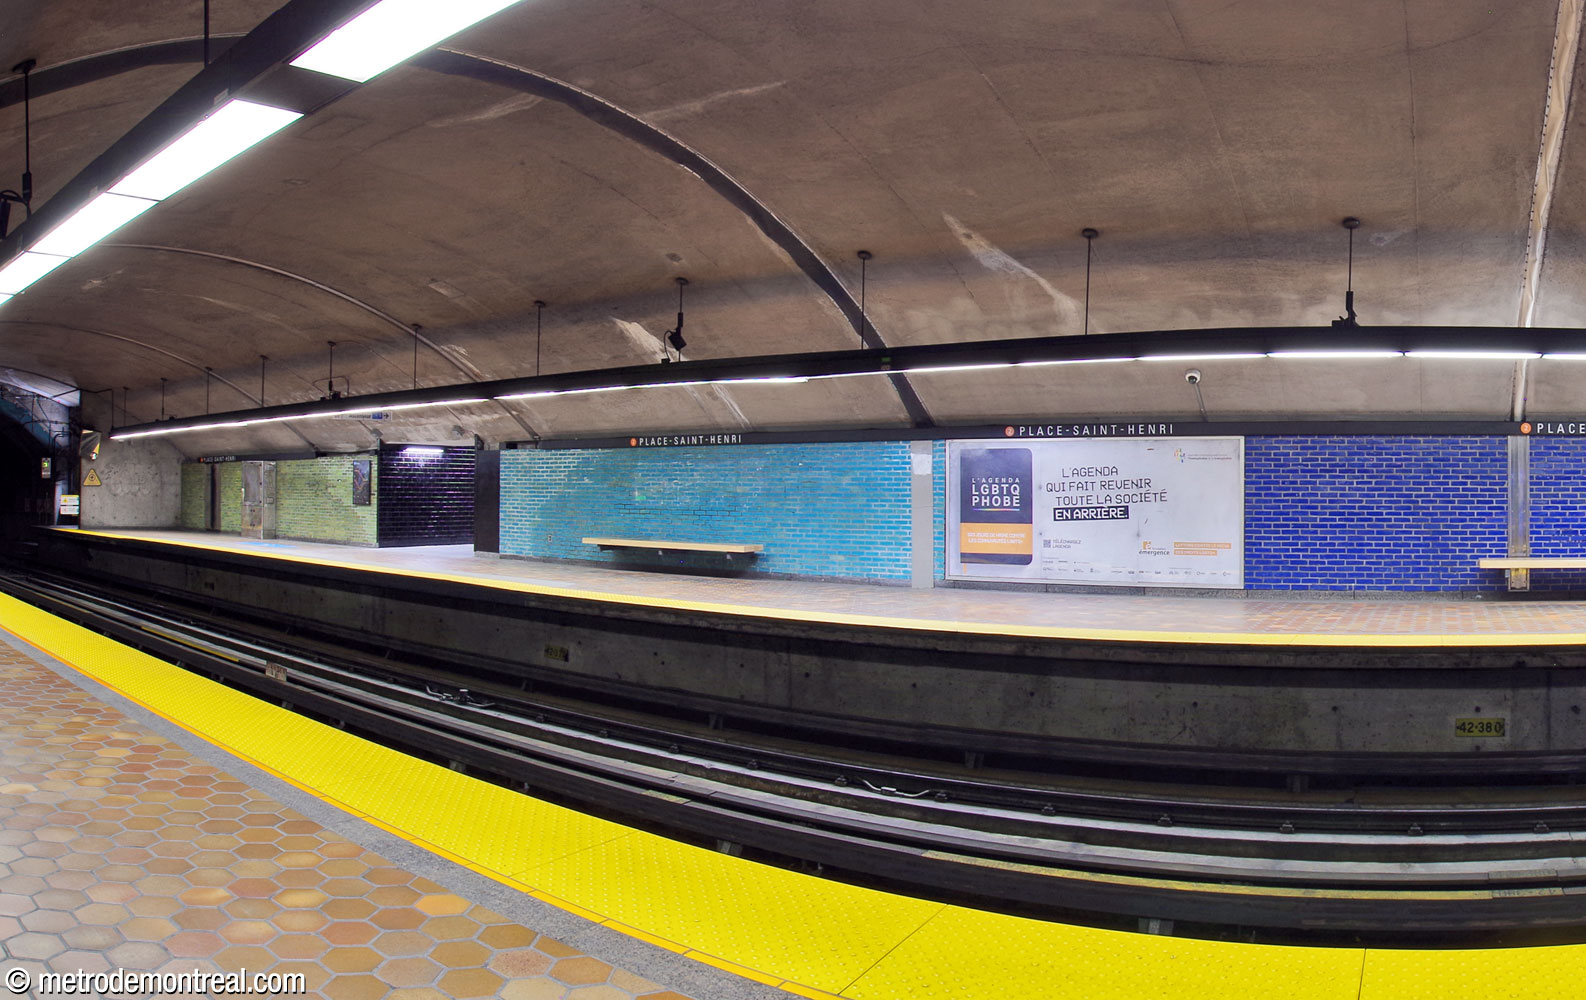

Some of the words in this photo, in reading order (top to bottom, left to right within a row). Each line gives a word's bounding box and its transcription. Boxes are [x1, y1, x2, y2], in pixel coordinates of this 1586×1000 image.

[1019, 424, 1173, 436] PLACE-SAINT-HENRI
[639, 435, 742, 446] PLACE-SAINT-HENRI
[1062, 466, 1118, 477] L'AGENDA
[972, 484, 1020, 496] LGBTQ
[1046, 482, 1065, 492] QUI
[1069, 481, 1096, 491] FAIT
[1100, 478, 1152, 490] REVENIR
[972, 496, 1020, 506] PHOBE
[1056, 495, 1093, 506] TOUTE
[1097, 494, 1112, 504] LA
[1115, 489, 1168, 504] SOCIÉTÉ
[1055, 509, 1071, 519] EN
